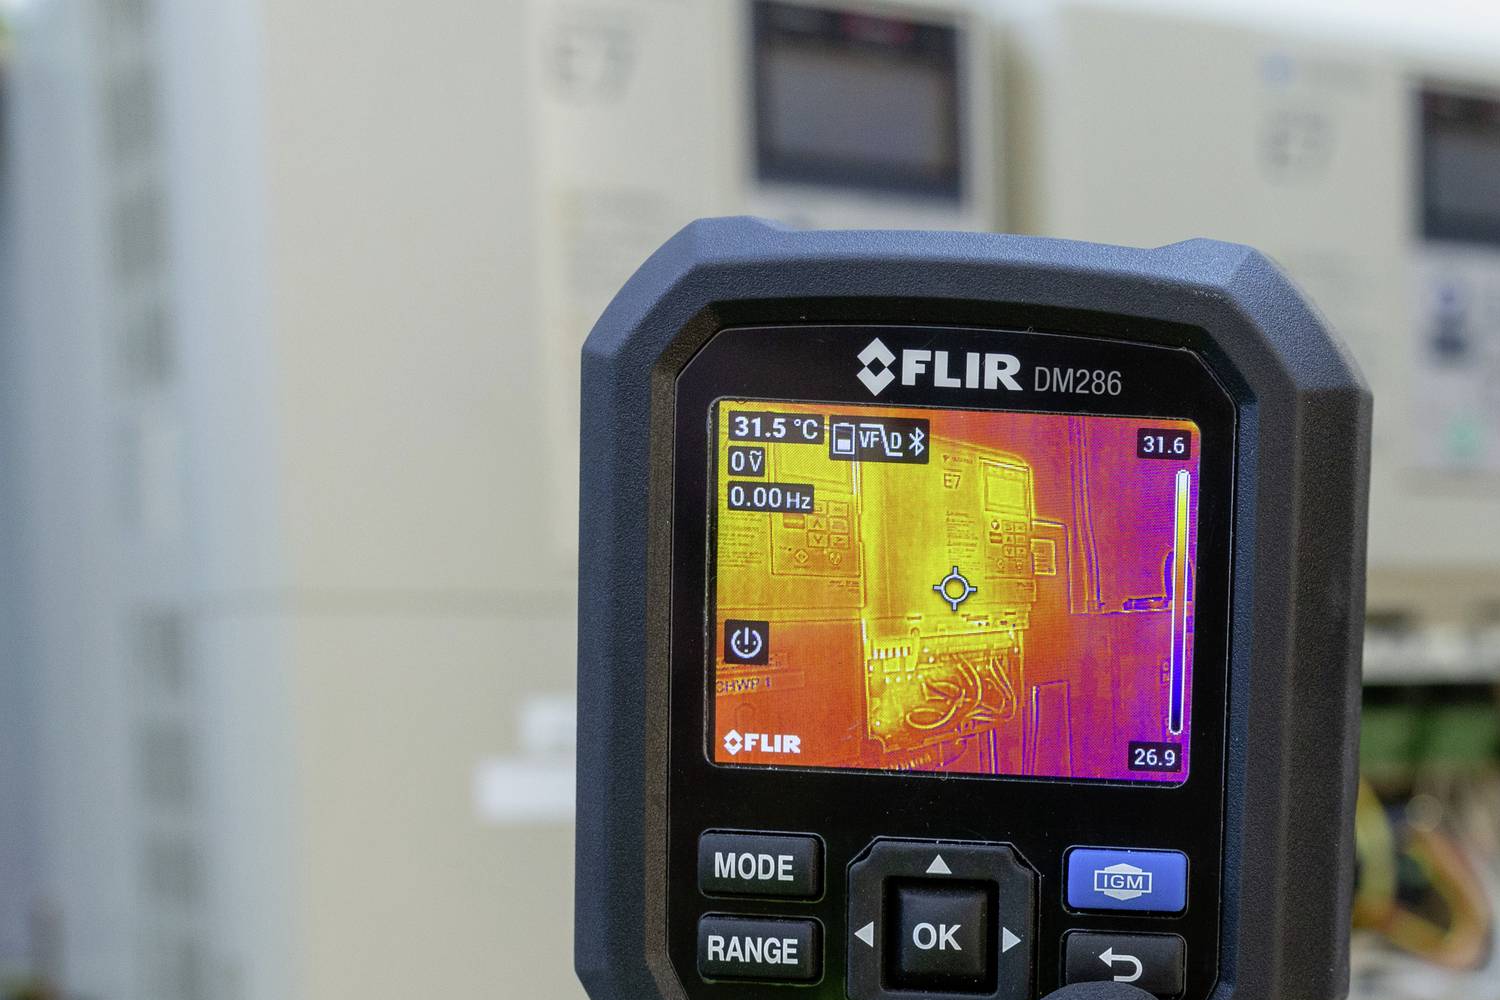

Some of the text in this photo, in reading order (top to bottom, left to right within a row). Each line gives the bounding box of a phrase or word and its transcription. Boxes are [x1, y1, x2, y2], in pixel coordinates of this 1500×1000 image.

[902, 349, 1122, 396] FLIR DM286
[735, 416, 818, 439] 31.5 °C
[1143, 435, 1185, 454] 31.6
[731, 451, 745, 471] 0
[731, 486, 811, 509] 0.00 Hz
[744, 733, 801, 753] FLIR
[1134, 749, 1176, 766] 26.9
[714, 852, 794, 882] MODE
[1103, 873, 1144, 890] IGM
[913, 923, 961, 951] OK
[707, 935, 798, 965] RANGE
